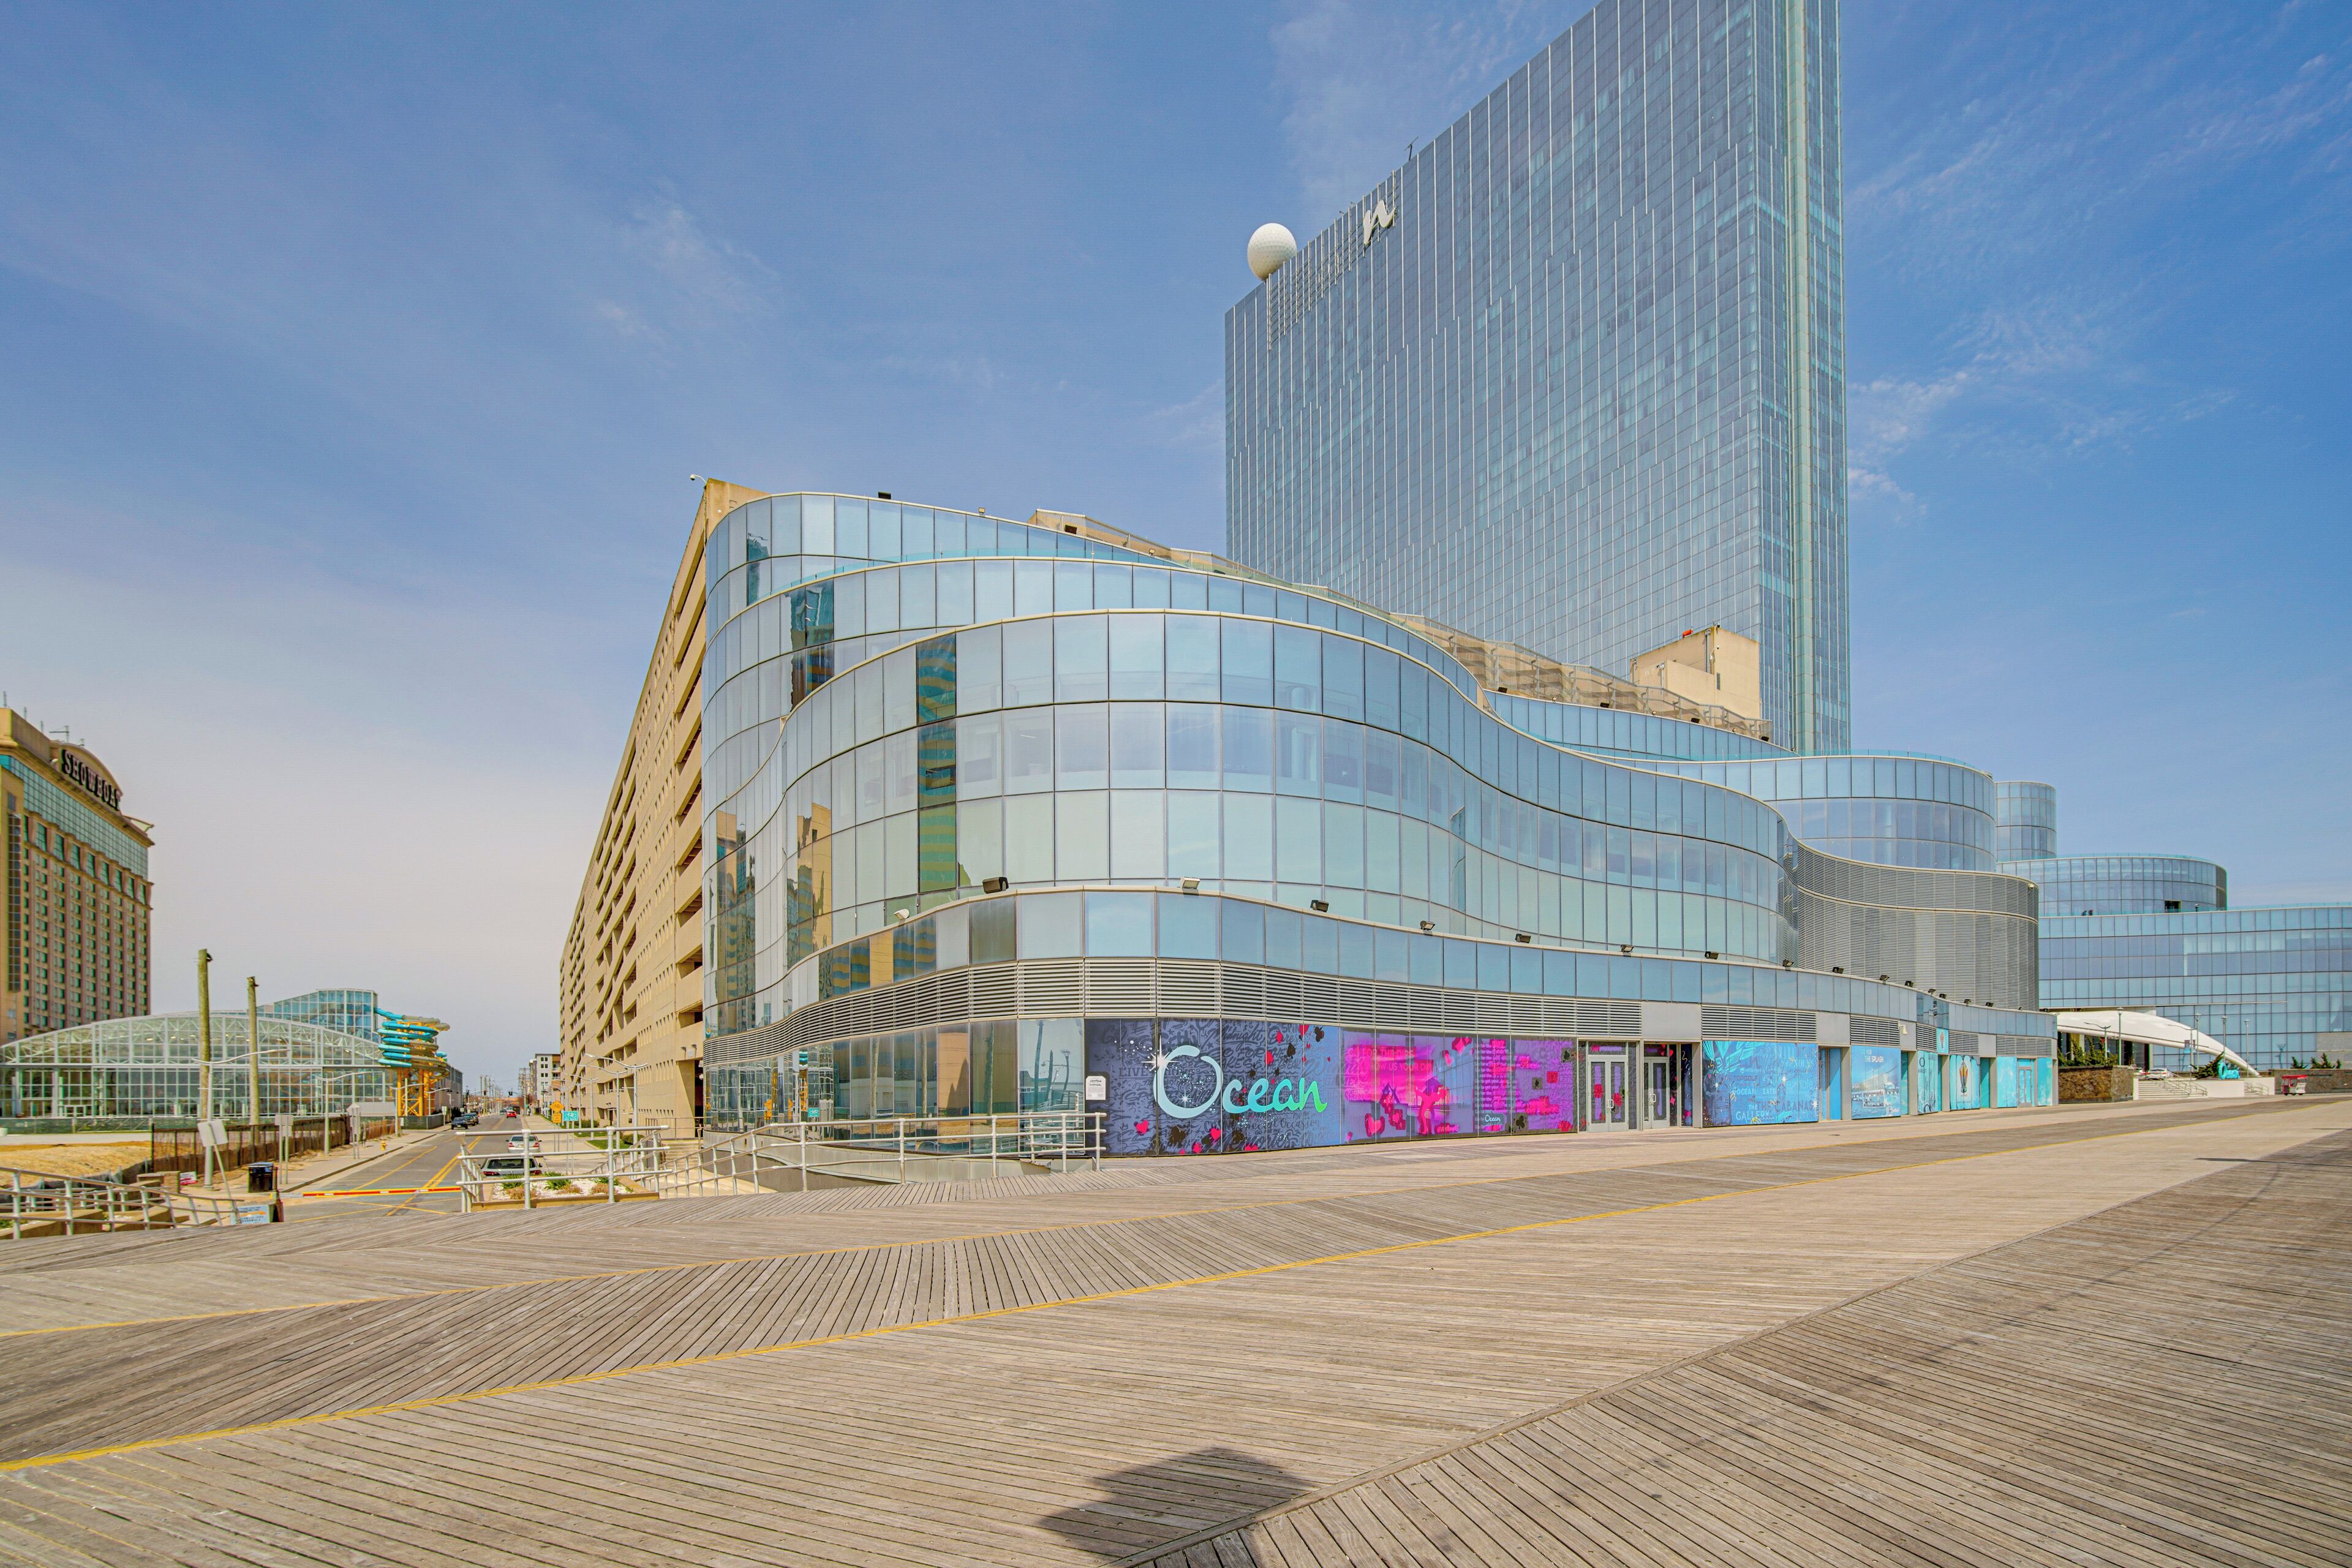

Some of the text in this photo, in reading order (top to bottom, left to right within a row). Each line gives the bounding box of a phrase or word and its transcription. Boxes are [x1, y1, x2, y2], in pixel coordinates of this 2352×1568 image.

[62, 749, 121, 812] SHOWBOAT
[1119, 1067, 1148, 1077] LIVE
[1154, 1045, 1328, 1119] Ocean
